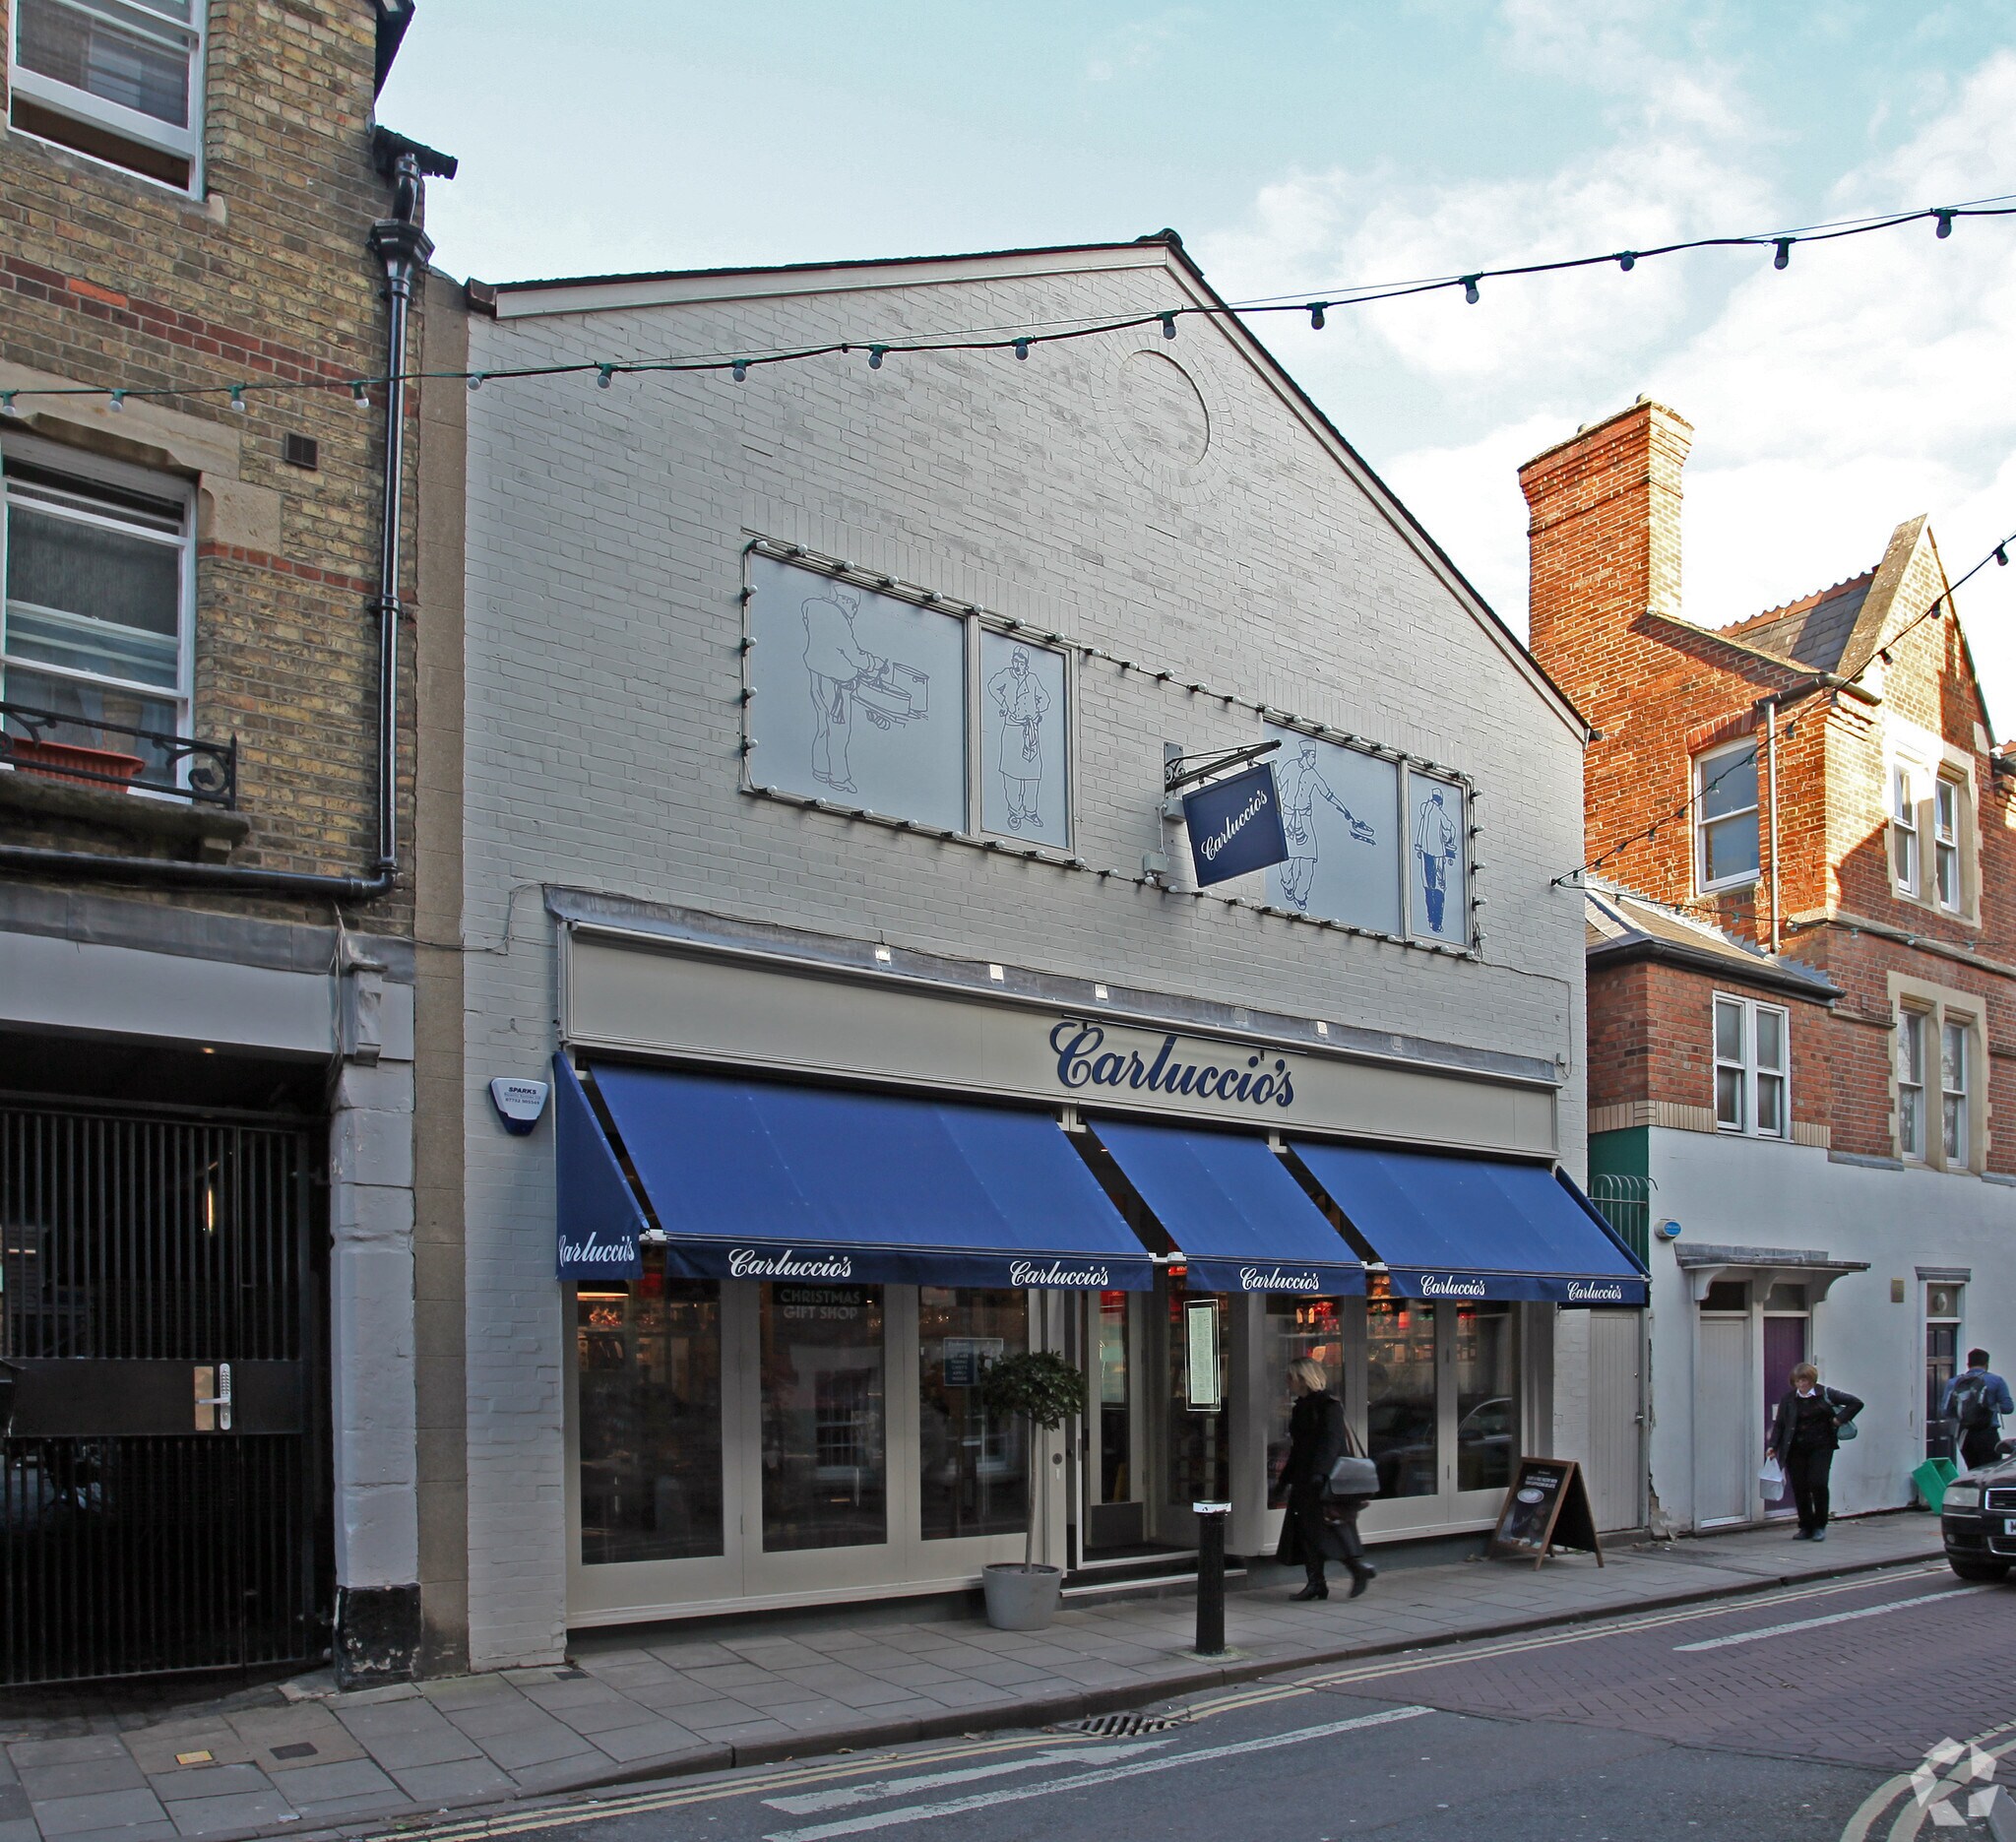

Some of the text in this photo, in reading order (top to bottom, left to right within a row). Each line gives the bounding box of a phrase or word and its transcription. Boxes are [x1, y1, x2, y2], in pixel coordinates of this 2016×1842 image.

[1200, 790, 1268, 861] Carluccio's
[1049, 1022, 1294, 1108] Carluccio's
[728, 1248, 851, 1278] Carluccio's
[1009, 1260, 1109, 1287] Carluccio's
[1239, 1267, 1320, 1291] Carluccio's
[1420, 1275, 1485, 1297] Carluccio's
[1567, 1281, 1622, 1301] Carluccio's
[781, 1289, 860, 1304] CHRISTMAS
[783, 1305, 858, 1320] GIFT SHOP
